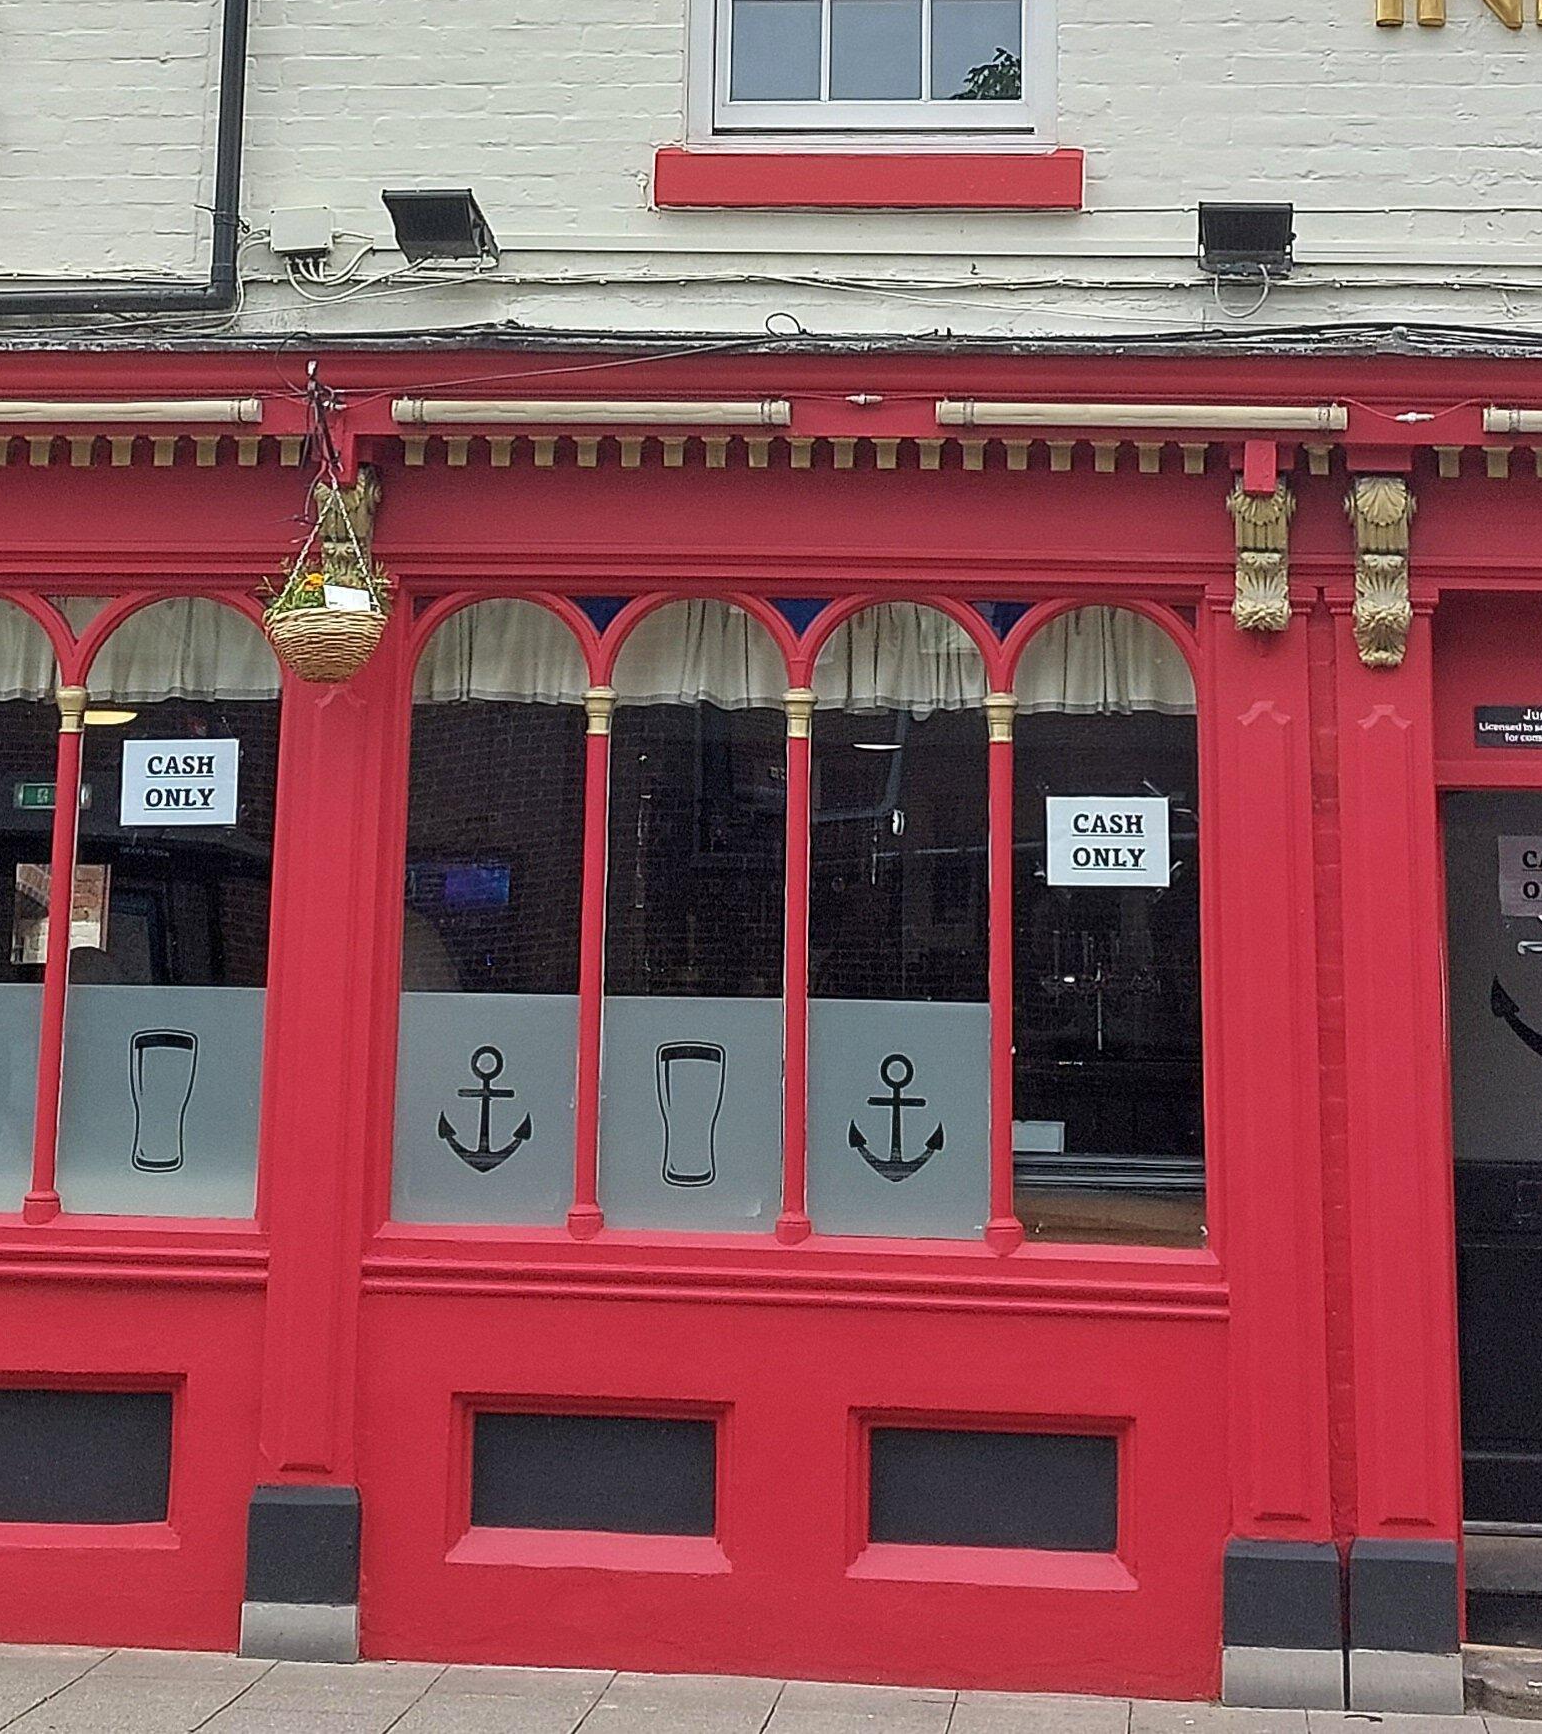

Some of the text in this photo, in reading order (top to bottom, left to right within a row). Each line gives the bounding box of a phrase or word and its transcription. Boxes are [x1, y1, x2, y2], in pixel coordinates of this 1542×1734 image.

[1478, 722, 1522, 732] Licensed
[1523, 723, 1534, 732] to
[1504, 733, 1519, 742] for
[147, 755, 216, 775] CASH
[145, 788, 216, 807] ONLY
[1073, 813, 1144, 834] CASH
[1072, 847, 1146, 867] ONLY
